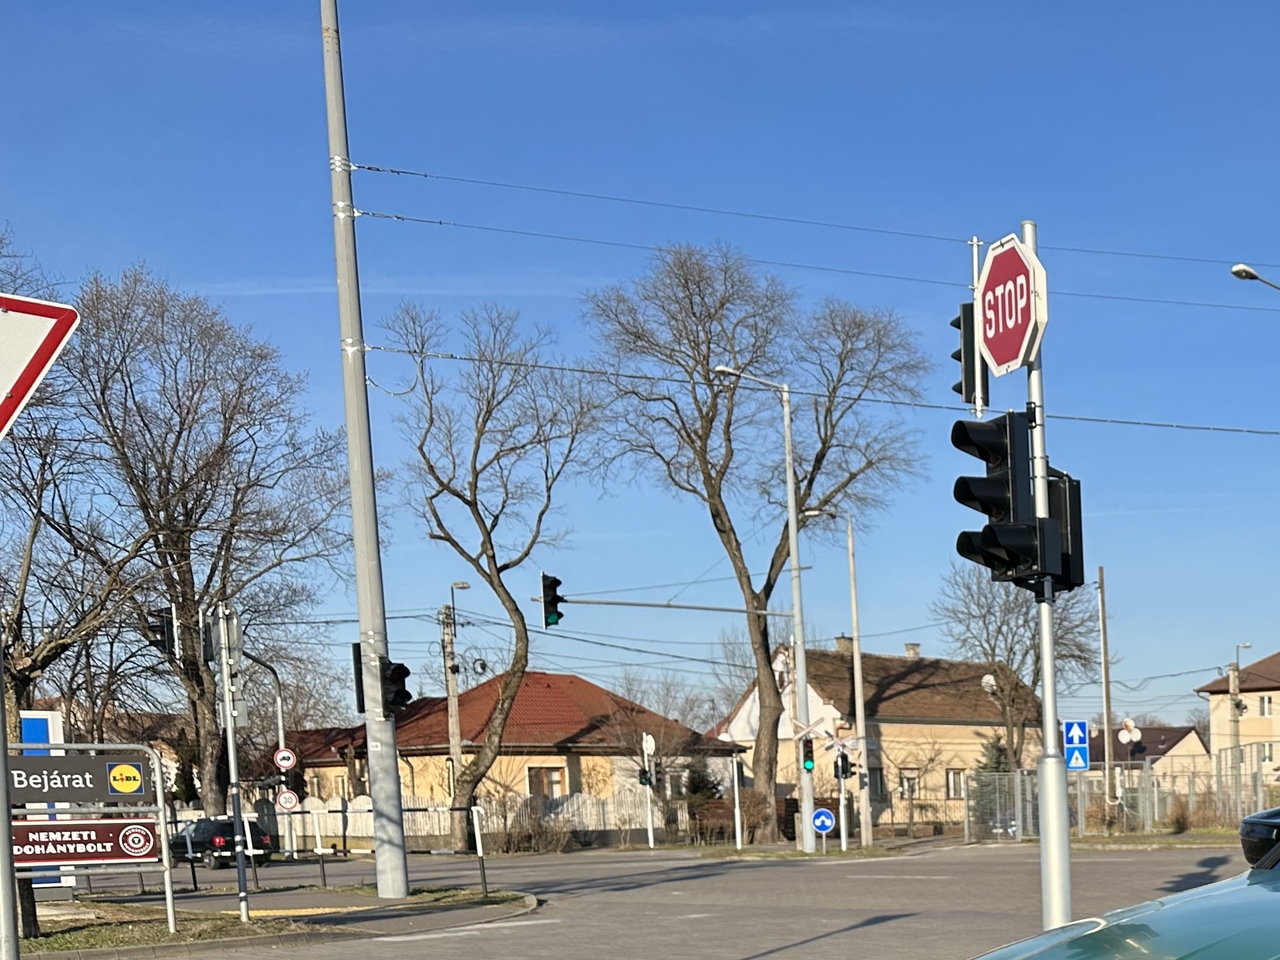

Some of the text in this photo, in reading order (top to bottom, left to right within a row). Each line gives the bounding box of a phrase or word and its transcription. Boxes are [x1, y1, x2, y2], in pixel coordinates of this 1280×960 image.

[985, 274, 1027, 339] STOP
[11, 770, 94, 792] Bejárat
[283, 796, 293, 804] 30
[28, 830, 97, 842] NEMZETI
[12, 842, 114, 855] DOHÁNYBOLT
